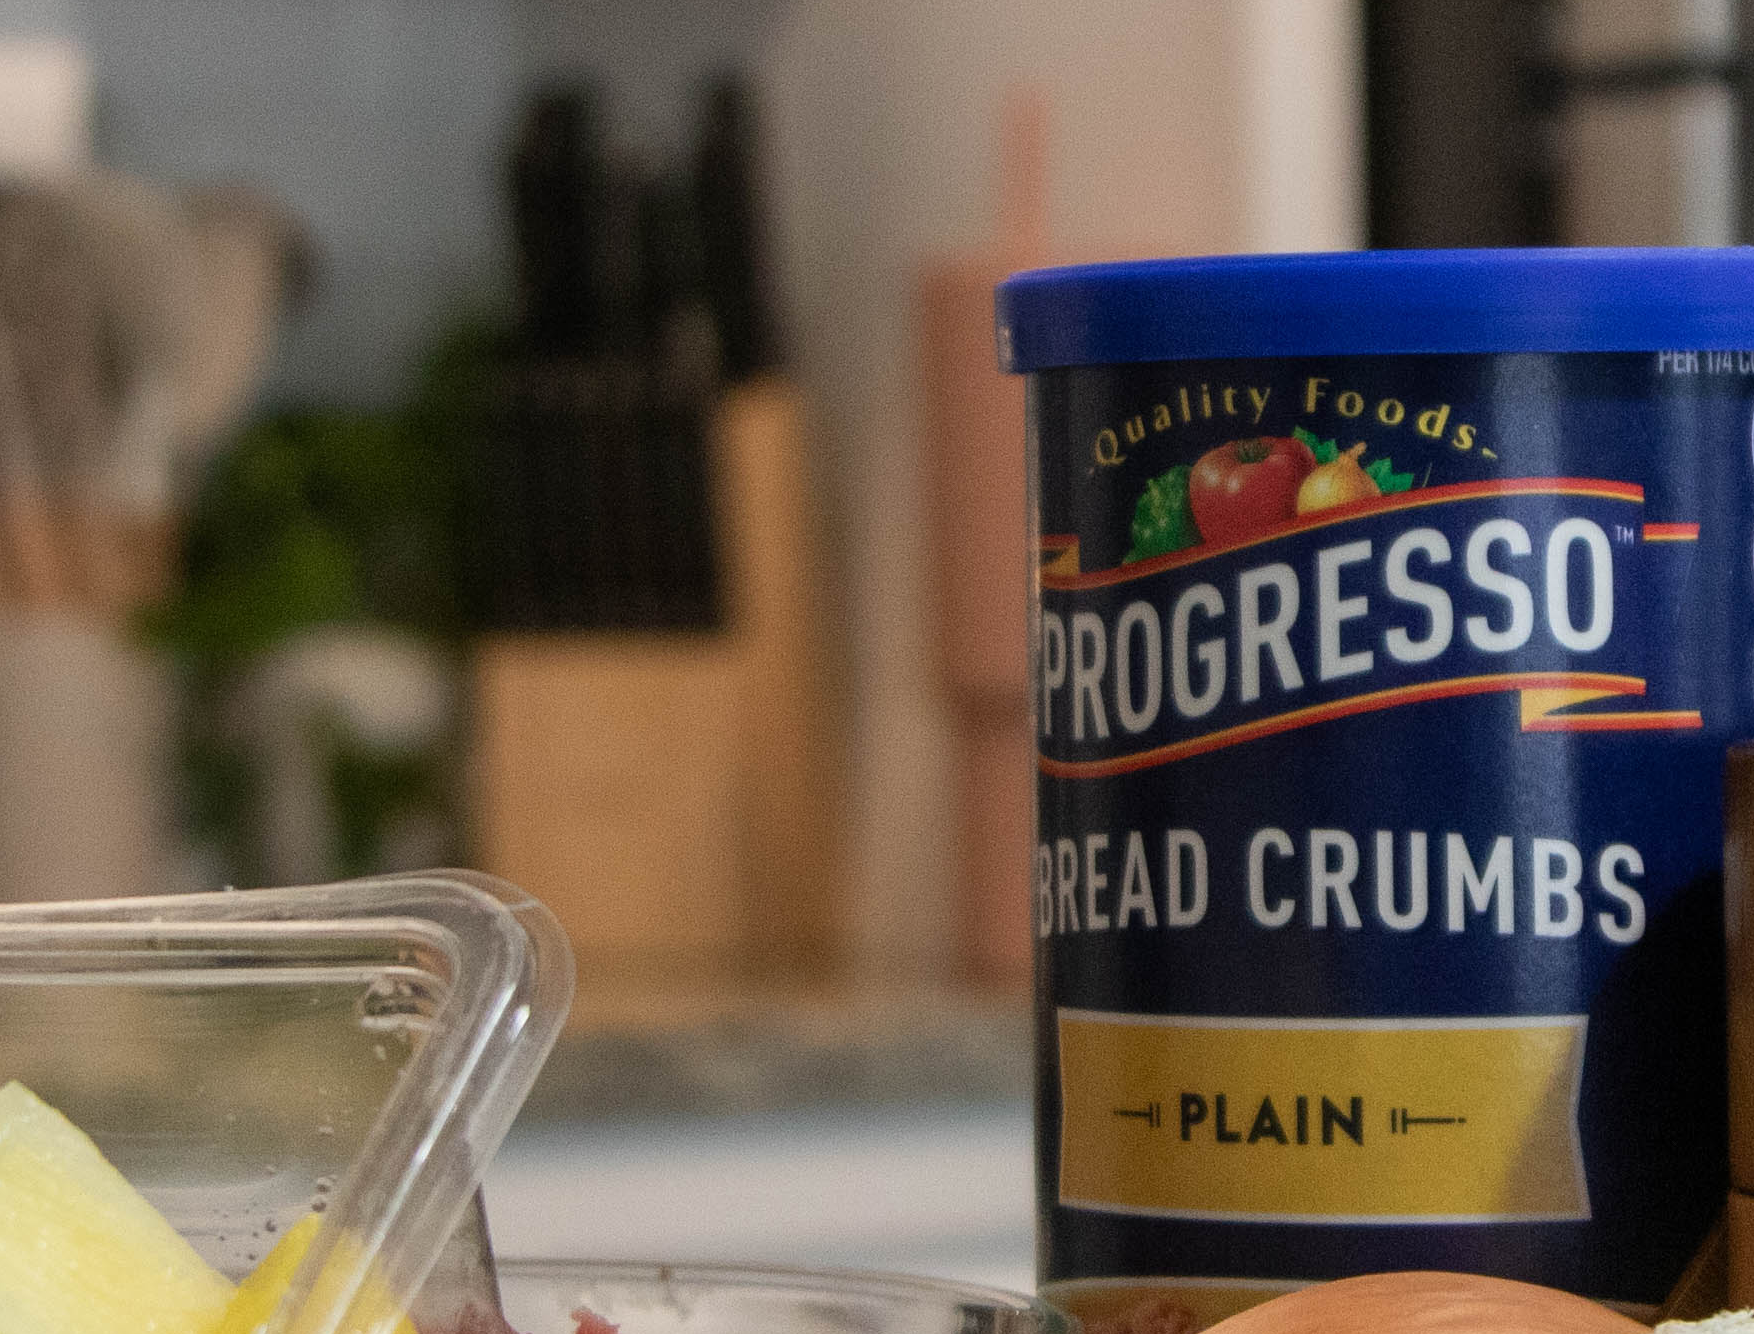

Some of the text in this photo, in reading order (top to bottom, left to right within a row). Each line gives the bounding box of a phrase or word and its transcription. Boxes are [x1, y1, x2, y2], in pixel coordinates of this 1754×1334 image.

[1094, 377, 1477, 467] Quality Foods
[1044, 517, 1615, 743] PROGRESSO
[1039, 827, 1648, 946] BREAD CRUMBS
[1178, 1091, 1365, 1147] PLAIN
